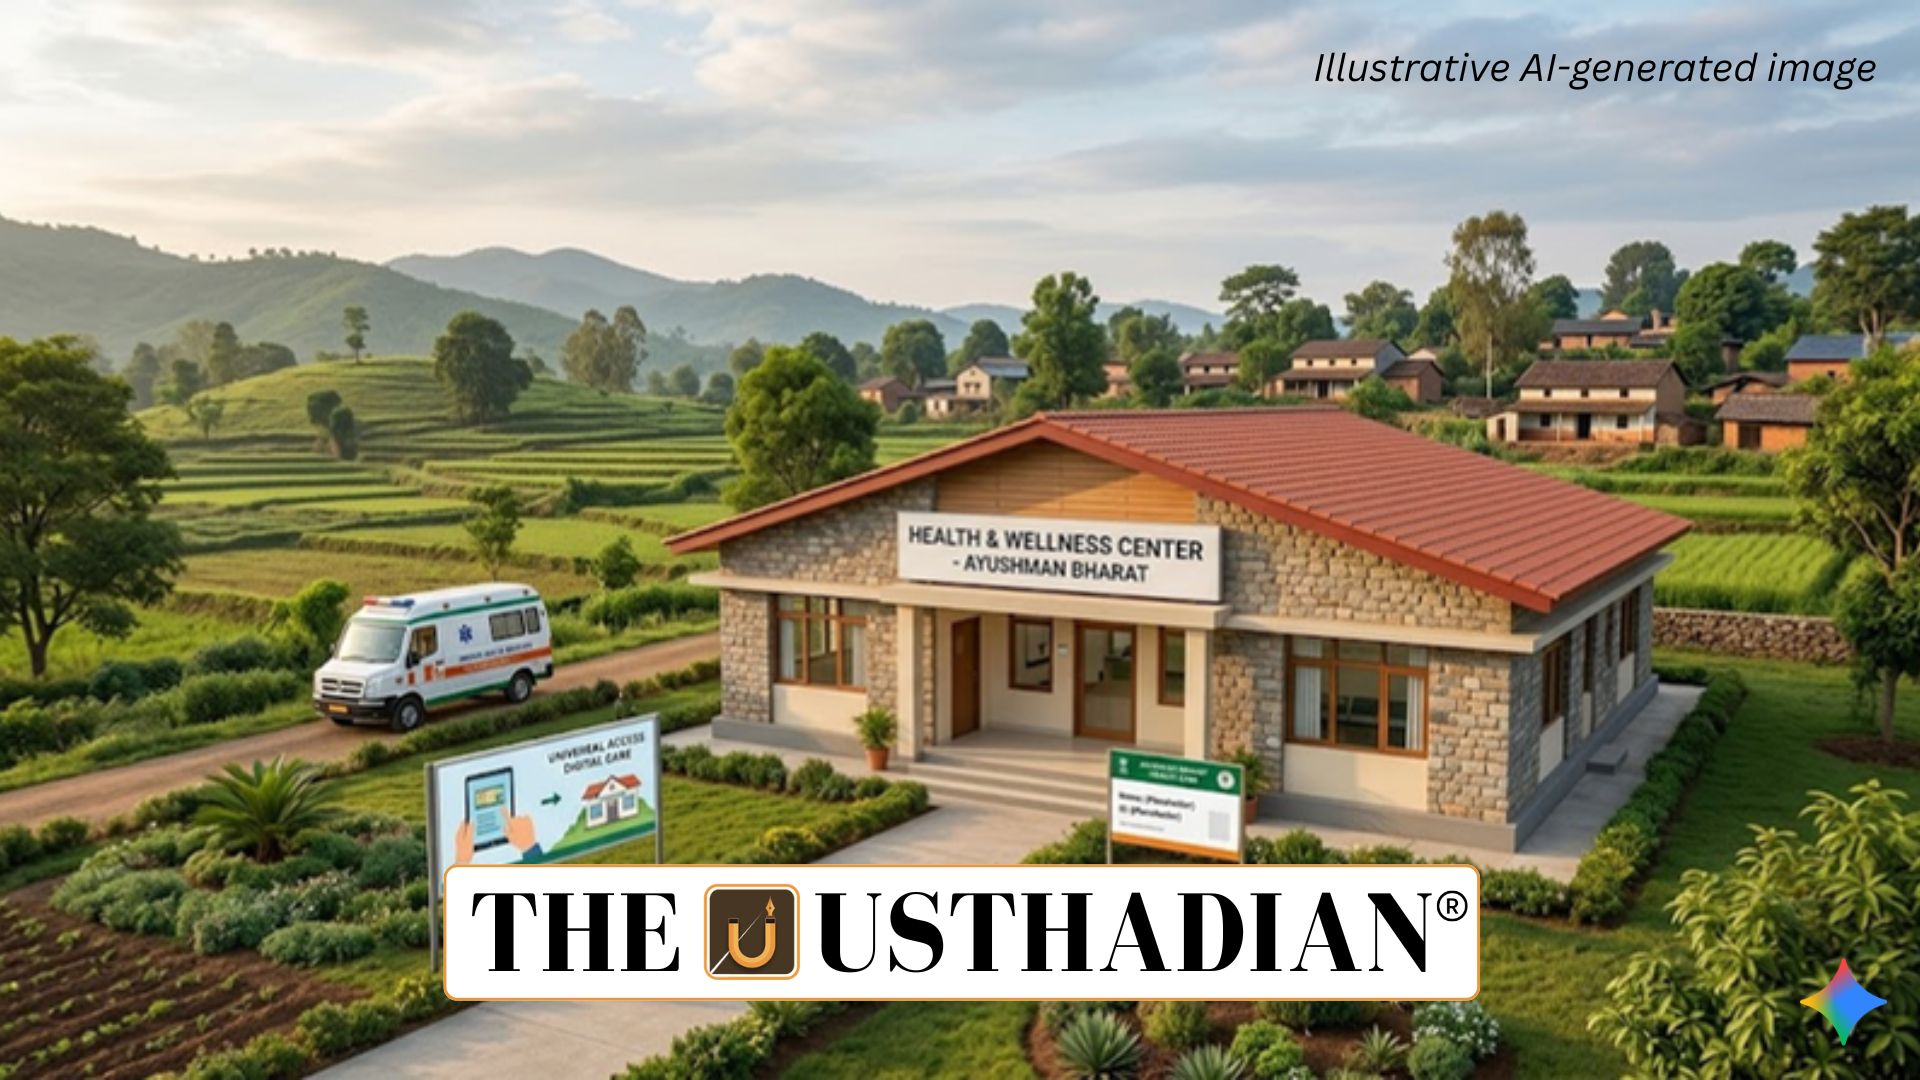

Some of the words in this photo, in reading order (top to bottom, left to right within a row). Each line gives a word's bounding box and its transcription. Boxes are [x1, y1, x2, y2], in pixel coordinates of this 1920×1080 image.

[908, 526, 981, 547] HEALTH
[986, 529, 999, 548] &
[1004, 531, 1113, 555] WELLNESS
[1118, 537, 1203, 561] CENTER
[963, 554, 1067, 577] AYUSHMAN
[1071, 562, 1149, 583] BHARAT
